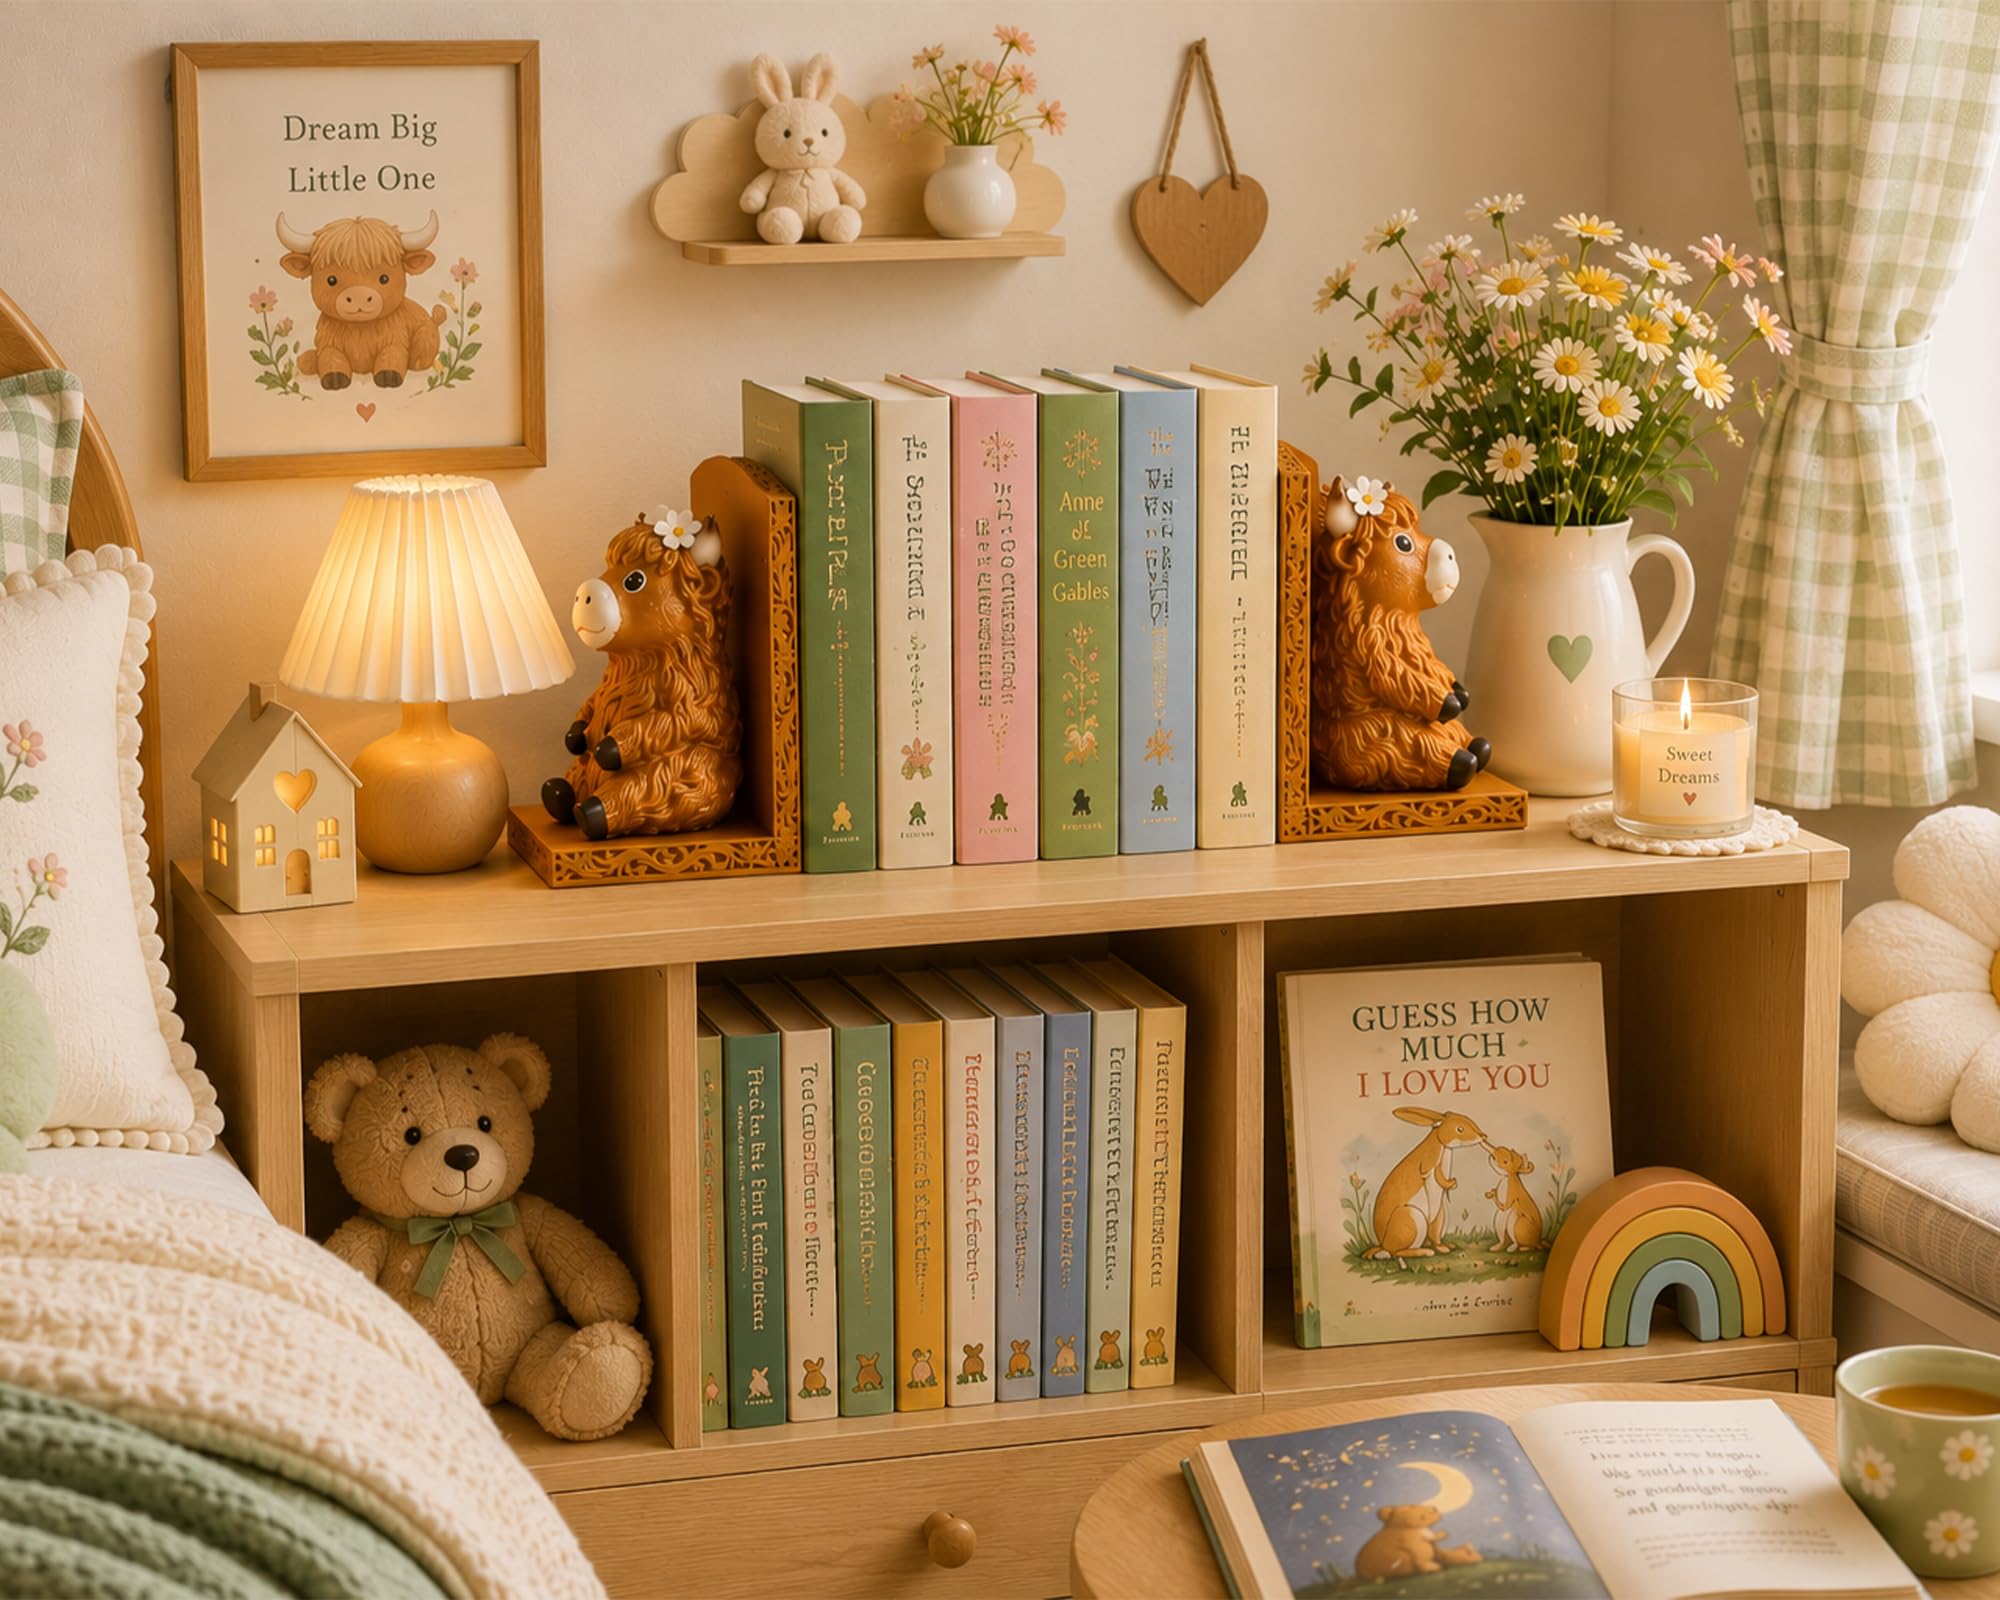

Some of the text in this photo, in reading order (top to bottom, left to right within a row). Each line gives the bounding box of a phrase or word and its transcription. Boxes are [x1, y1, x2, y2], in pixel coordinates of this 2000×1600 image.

[283, 113, 438, 147] Dream Big
[288, 165, 436, 193] Little One
[1058, 491, 1105, 513] Anne
[1053, 549, 1107, 570] Green
[1052, 579, 1110, 602] Gables
[1666, 746, 1713, 762] Sweet
[1658, 767, 1720, 784] Dreams
[1352, 997, 1551, 1032] GUESS HOW
[1400, 1032, 1507, 1063] MUCH
[1357, 1063, 1552, 1099] I LOVE YOU
